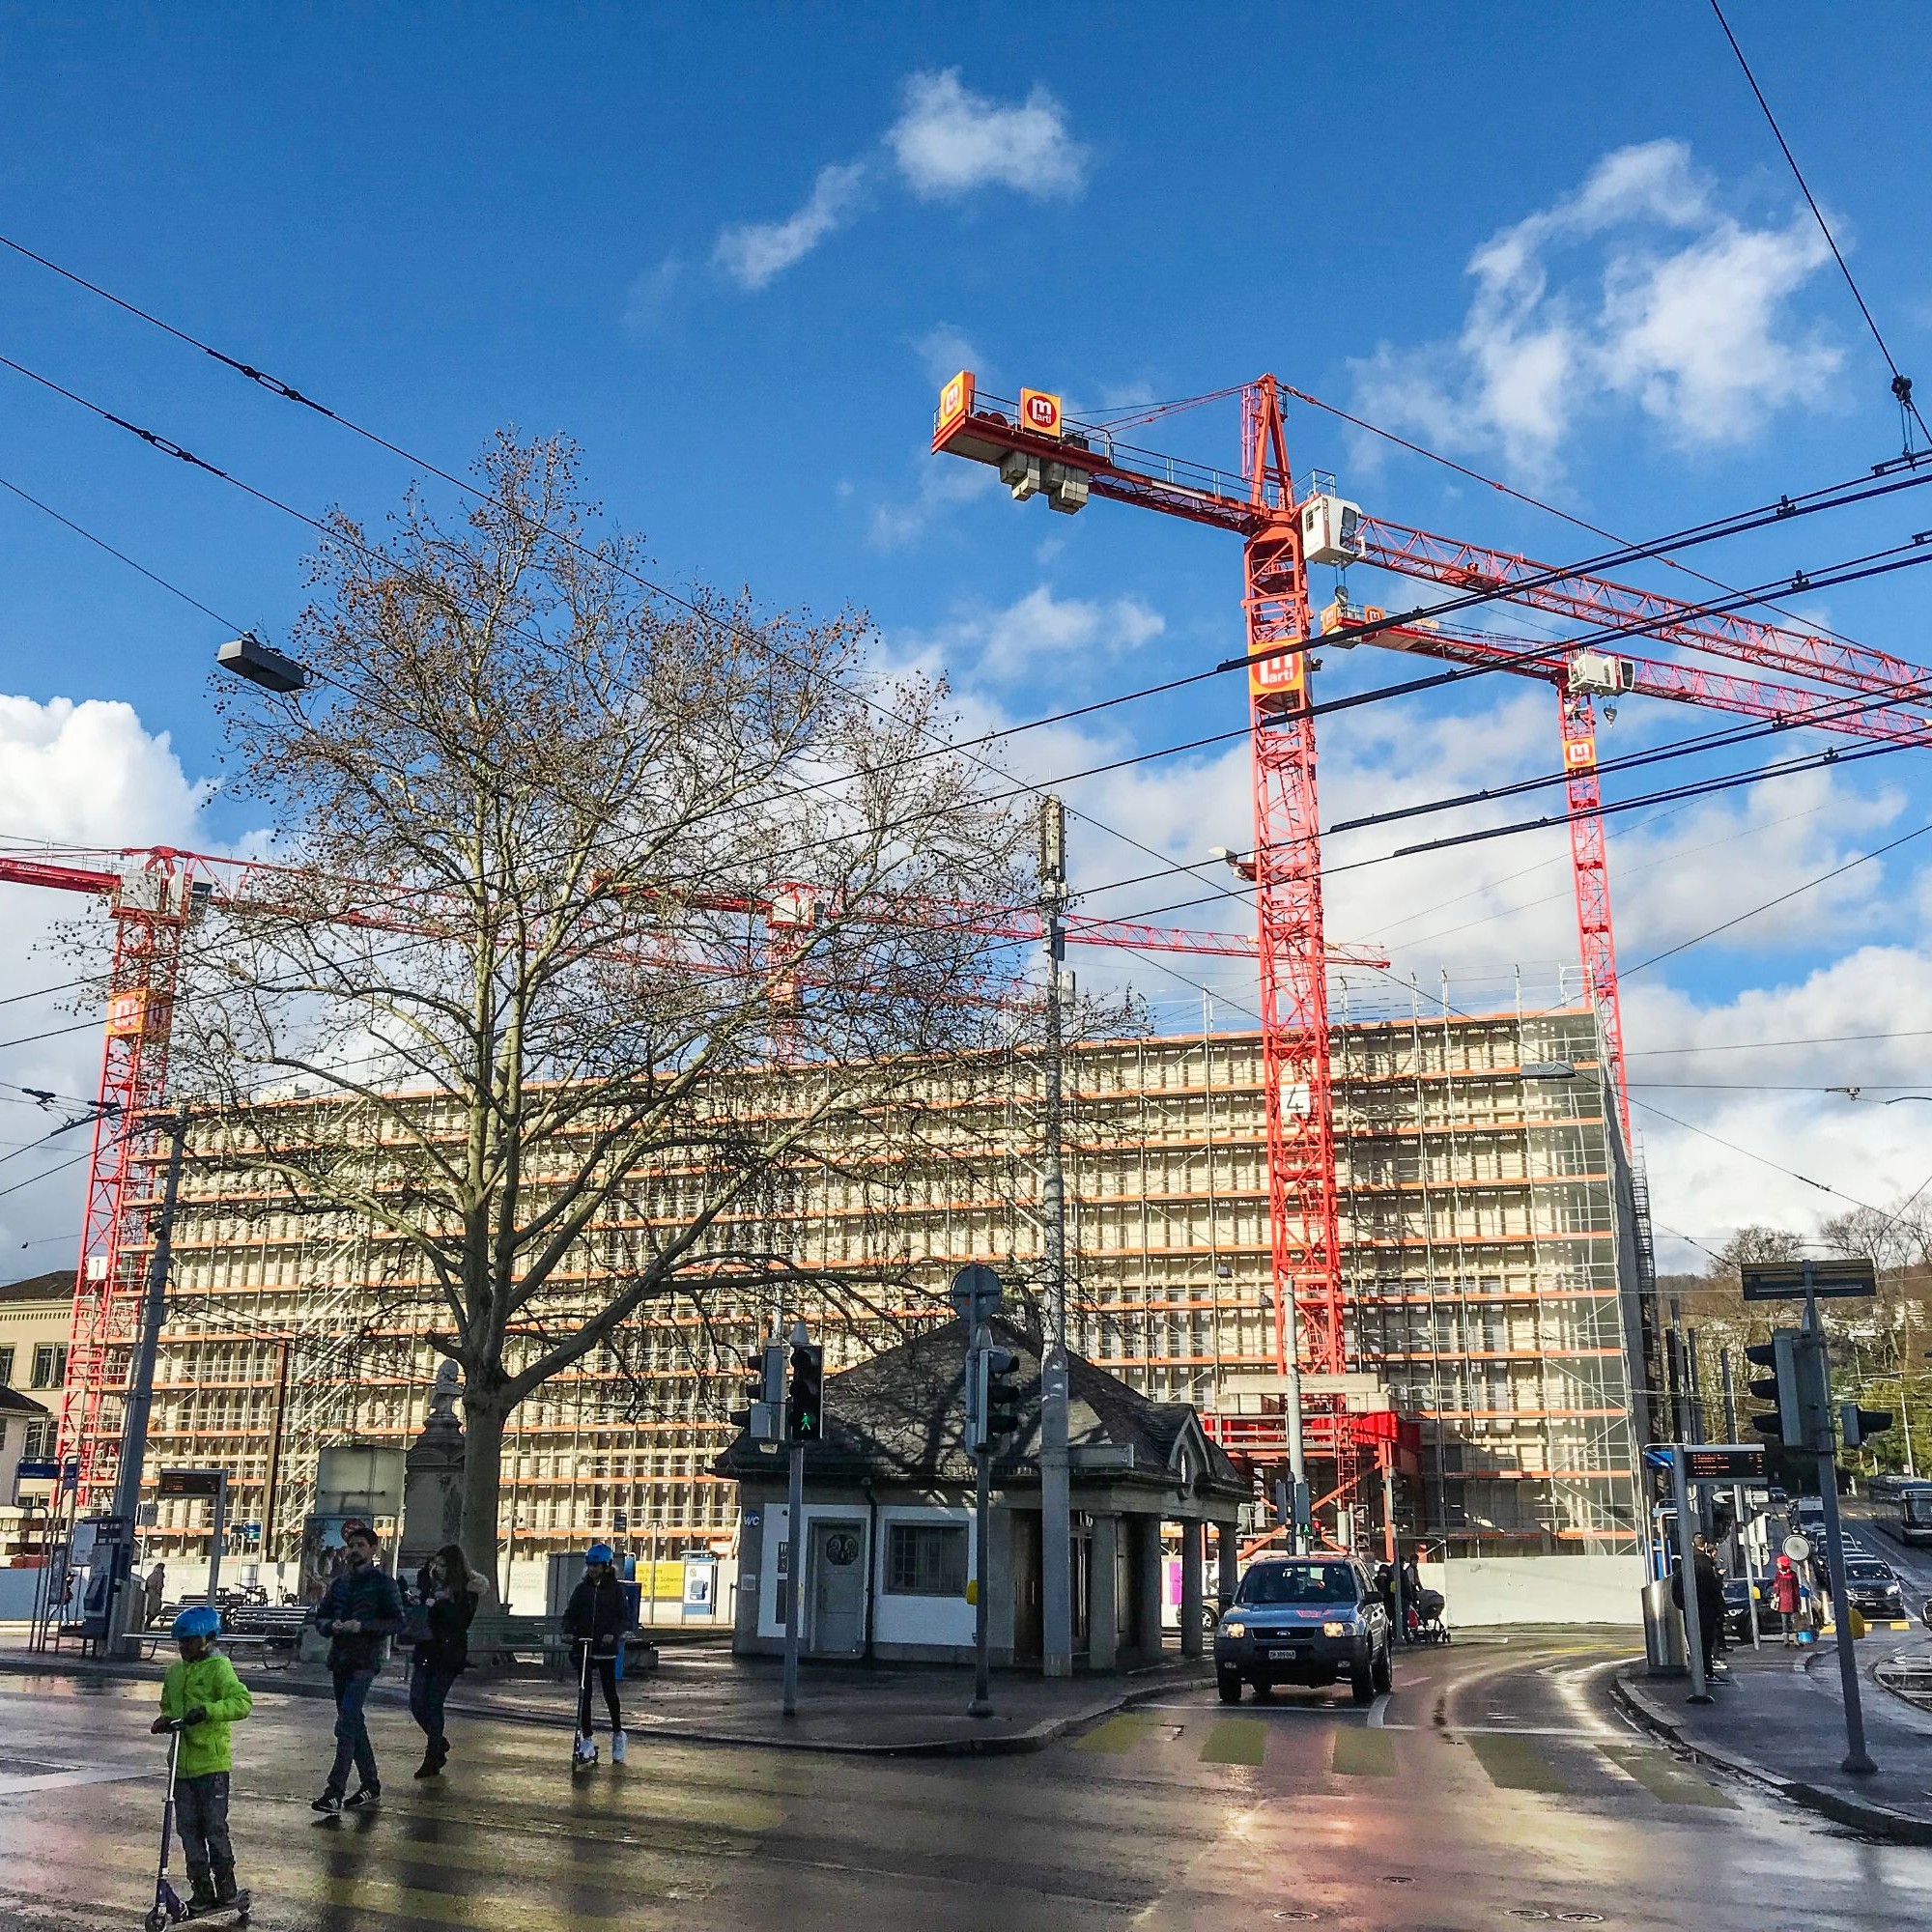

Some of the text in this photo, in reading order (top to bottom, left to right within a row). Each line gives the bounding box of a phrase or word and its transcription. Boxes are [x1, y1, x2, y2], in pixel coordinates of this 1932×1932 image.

[1032, 398, 1052, 424] marti
[1259, 653, 1294, 685] marti
[1286, 1086, 1304, 1112] 4
[95, 1259, 100, 1278] 1
[143, 1507, 156, 1517] TAXI
[744, 1516, 760, 1526] WC
